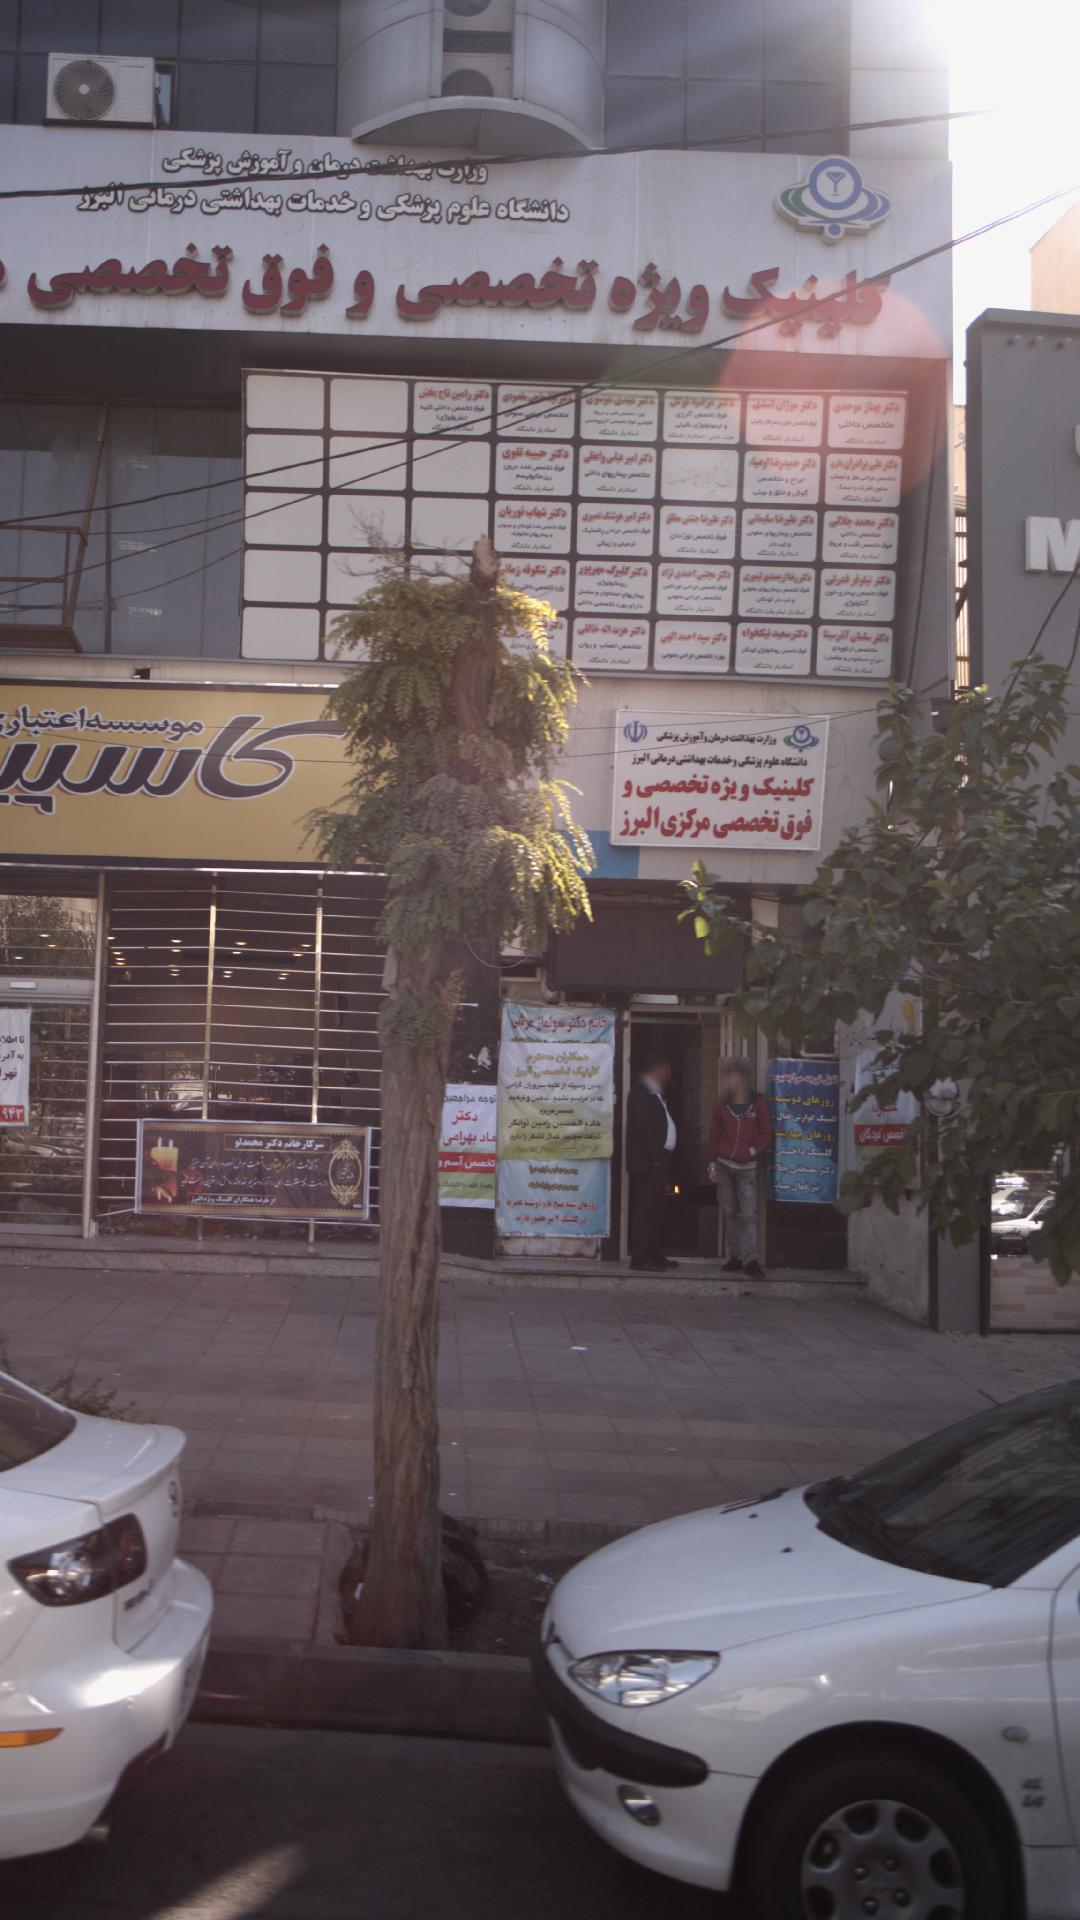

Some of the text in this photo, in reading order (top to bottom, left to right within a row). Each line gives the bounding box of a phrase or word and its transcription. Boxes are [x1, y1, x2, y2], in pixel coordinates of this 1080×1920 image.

[162, 147, 223, 177] پزشکی
[226, 148, 292, 176] آموزش
[291, 159, 304, 177] و
[77, 182, 570, 225] دانشگاه علوم پزشکی و خدمات بهداشتی درمانی البرز
[27, 241, 234, 310] تخصصی
[241, 243, 335, 318] فوق
[345, 270, 376, 321] و
[395, 256, 600, 322] تخصصی
[607, 262, 710, 334] ویژه
[720, 266, 891, 338] کلینیک
[474, 388, 490, 401] دکتر
[882, 402, 899, 414] دکتر
[549, 449, 569, 461] دکتر
[638, 453, 653, 465] دکتر
[800, 458, 817, 471] دکتر
[883, 460, 898, 472] دکتر
[549, 508, 567, 520] دکتر
[637, 511, 651, 523] دکتر
[719, 514, 734, 526] دکتر
[798, 514, 815, 526] دکتر
[877, 517, 895, 529] دکتر
[548, 565, 567, 578] دکتر
[629, 567, 648, 579] دکتر
[716, 570, 731, 581] دکتر
[873, 575, 891, 587] دکتر
[629, 626, 646, 638] دکتر
[789, 628, 808, 641] دکتر
[872, 633, 889, 644] دکتر
[711, 633, 728, 645] دکتر
[85, 713, 205, 743] موسسه
[656, 731, 680, 744] پزشکی
[680, 730, 705, 744] آموزش
[708, 733, 730, 745] درمان
[730, 733, 756, 745] بهداشت
[757, 735, 777, 746] وزارت
[631, 752, 809, 768] دانشگاه علوم پزشکی و خدمات بهداشتی درمانی البرز
[621, 773, 815, 802] کلینیک ویژه تخصصی و
[618, 805, 813, 841] فوق تخصصی مرکزی البرز
[568, 1015, 587, 1032] دکتر
[0, 1050, 17, 1062] آدر
[571, 1065, 600, 1078] کلینیک
[478, 1094, 497, 1105] توجه
[451, 1110, 478, 1125] دکتر
[264, 1137, 283, 1150] دکتر
[283, 1138, 302, 1150] خانم
